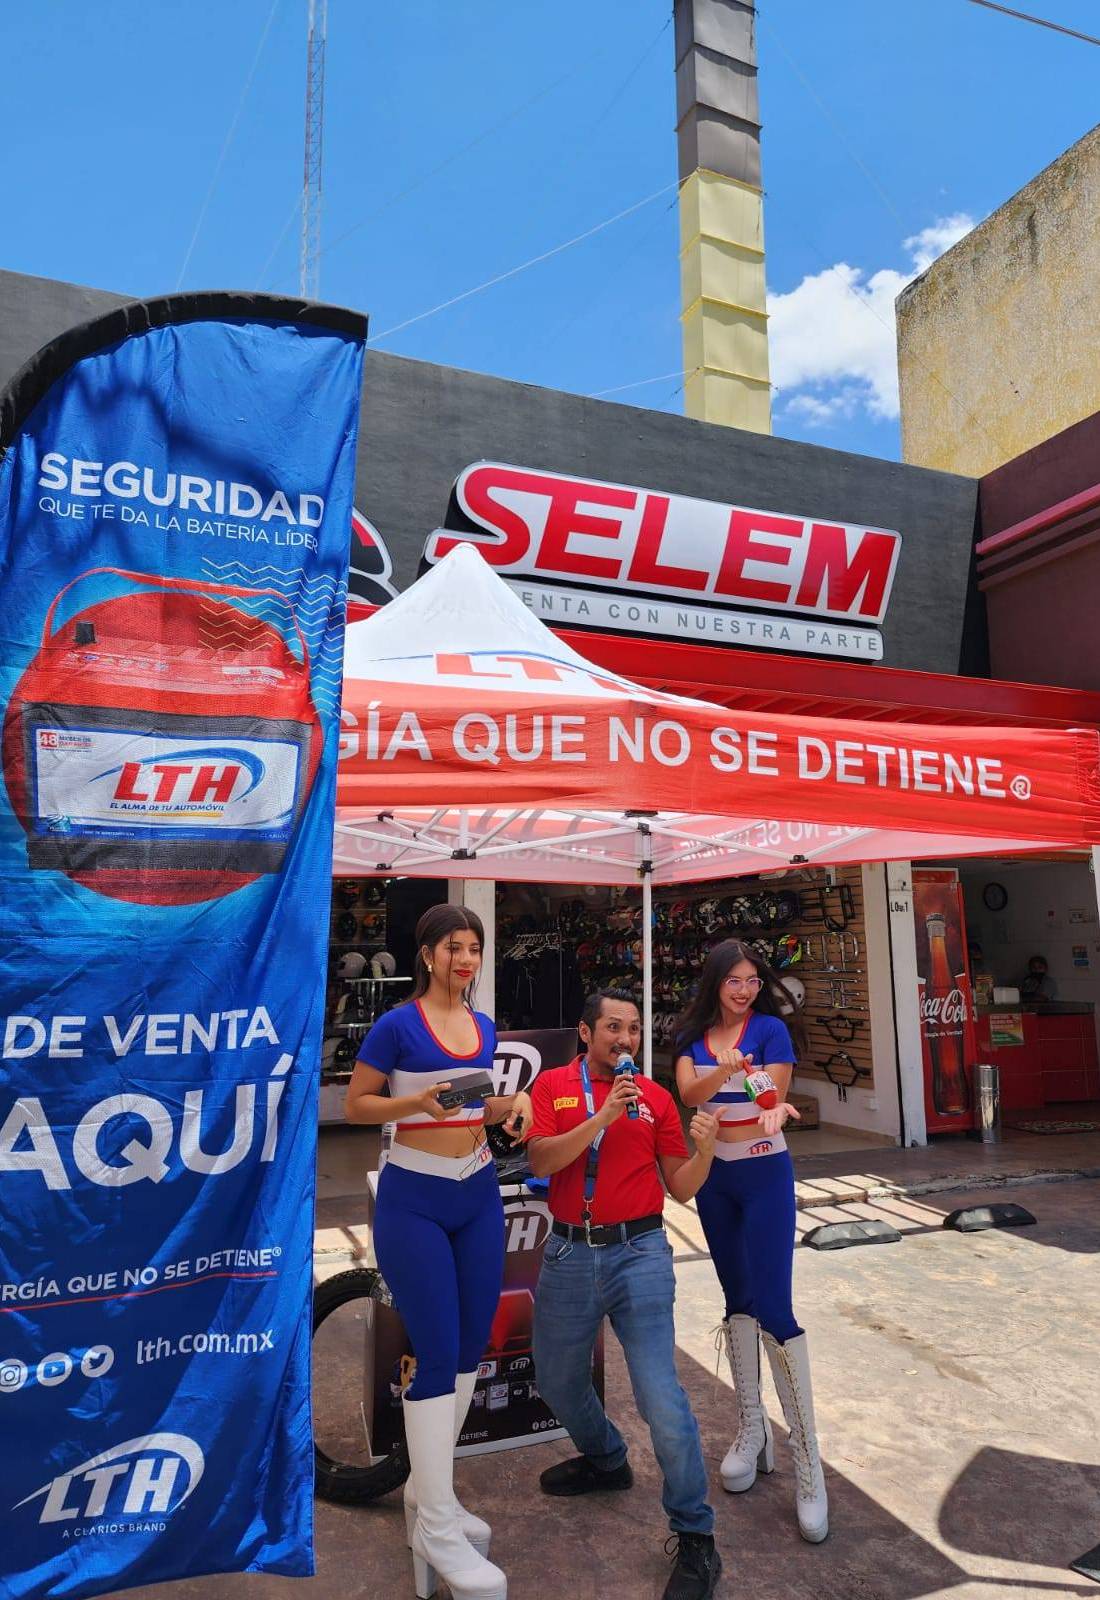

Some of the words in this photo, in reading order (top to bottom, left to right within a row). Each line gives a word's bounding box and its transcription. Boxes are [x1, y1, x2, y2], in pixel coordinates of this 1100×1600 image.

[37, 452, 325, 529] SEGURIDAD
[39, 496, 85, 520] QUE
[90, 504, 116, 519] TE
[121, 506, 150, 527] DA
[155, 513, 181, 531] LA
[187, 518, 270, 544] BATERÍA
[274, 529, 319, 554] LÍDER
[434, 466, 897, 618] SELEM
[608, 603, 659, 624] CON
[676, 612, 791, 641] NUESTRA
[806, 629, 878, 651] PARTE
[452, 712, 587, 766] QUE
[608, 716, 692, 767] NO
[709, 726, 779, 777] SE
[113, 761, 242, 803] LTH
[120, 802, 146, 810] ALMA
[174, 803, 225, 812] AUTOMÓVIL
[2, 1015, 87, 1059] DE
[103, 1005, 280, 1057] VENTA
[0, 1053, 294, 1191] AQUÍ
[750, 1143, 769, 1155] LTH
[0, 1276, 60, 1301] RGÍA
[67, 1271, 118, 1293] QUE
[123, 1267, 158, 1287] NO
[163, 1260, 190, 1280] SE
[136, 1329, 274, 1366] lth.com.mx
[39, 1457, 181, 1524] LTH
[62, 1529, 70, 1538] A
[74, 1523, 125, 1537] CLARIOS
[128, 1522, 166, 1533] BRAND
